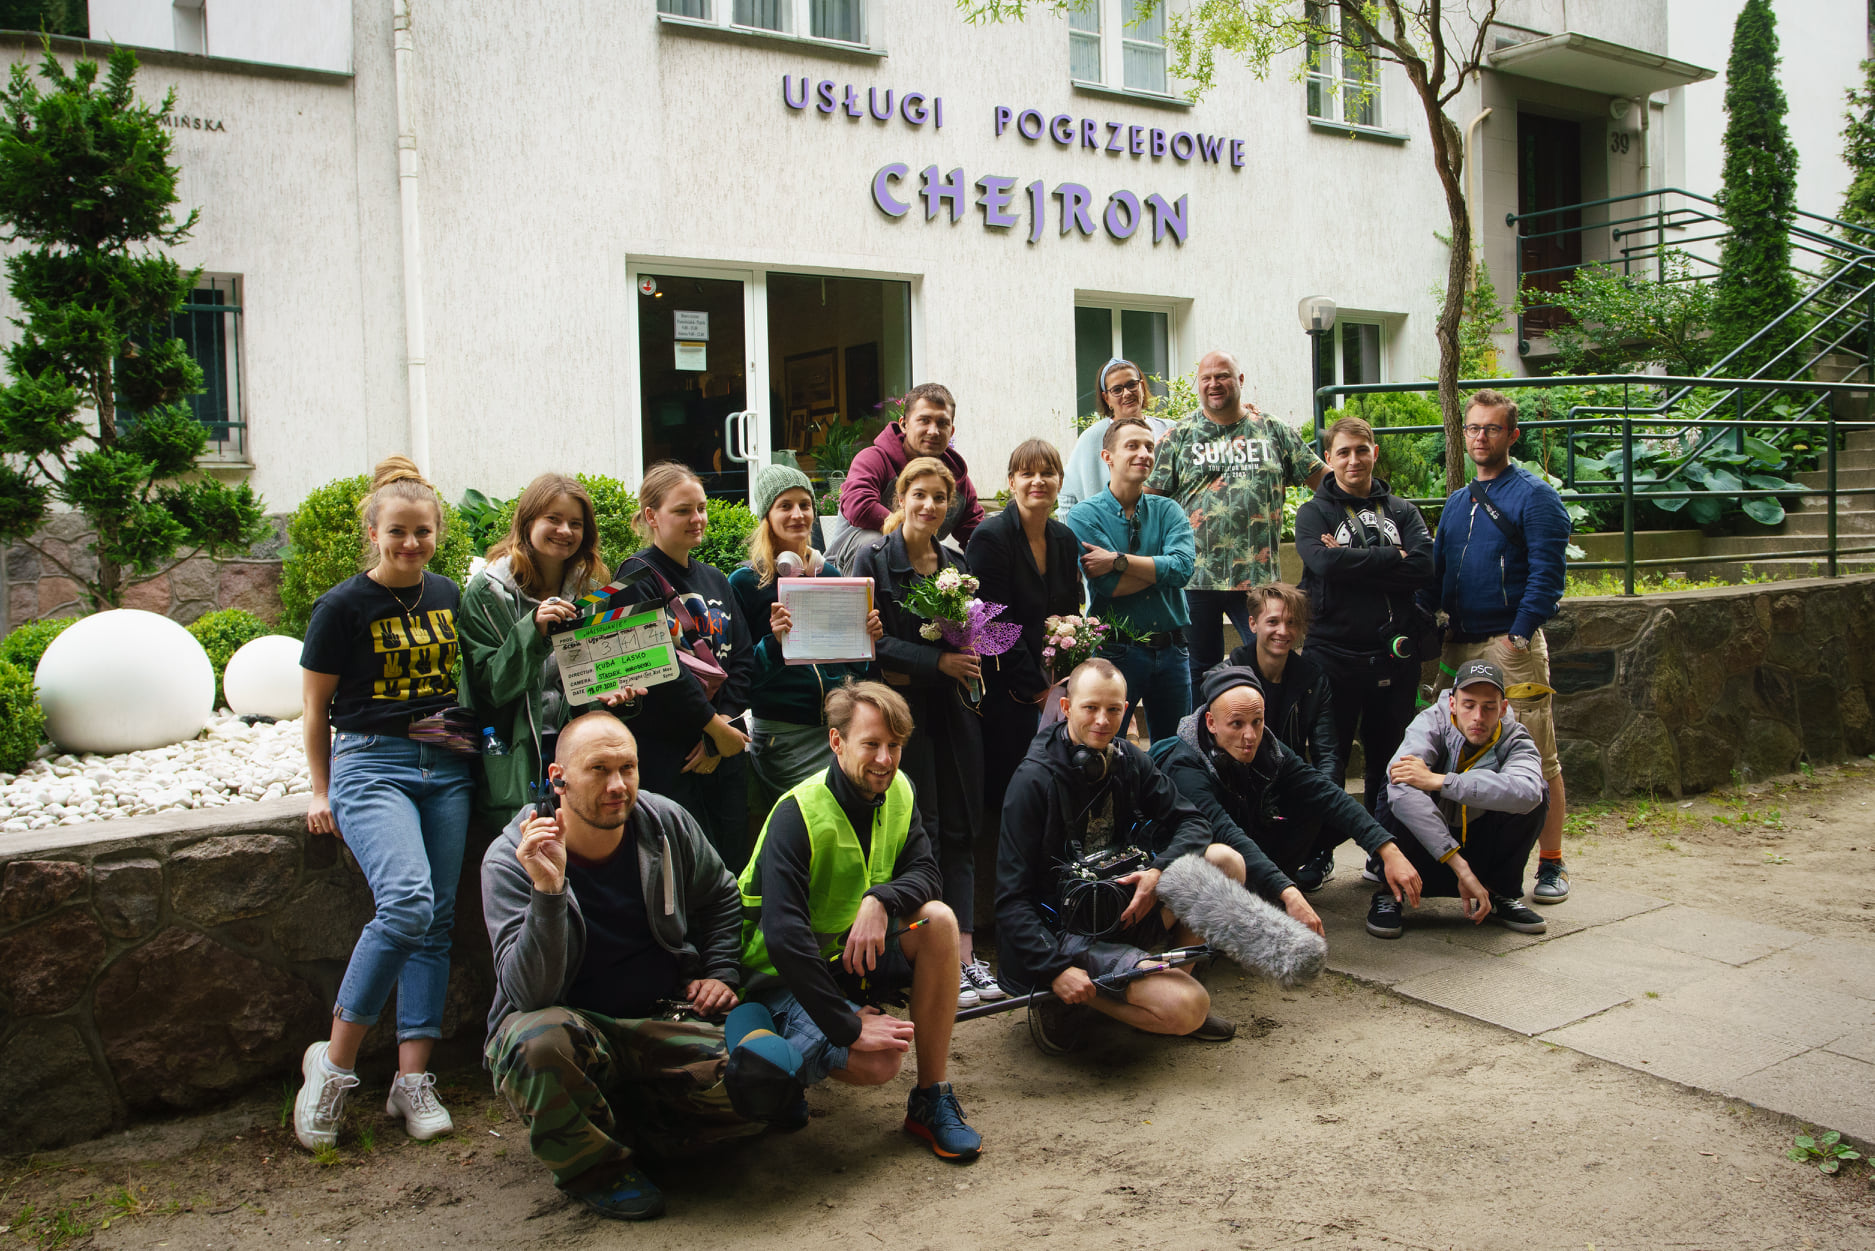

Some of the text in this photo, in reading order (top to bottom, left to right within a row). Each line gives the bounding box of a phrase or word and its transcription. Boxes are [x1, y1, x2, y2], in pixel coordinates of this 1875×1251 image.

[158, 114, 226, 132] MIŃSKA
[783, 74, 1246, 168] USŁUGI POGRZEBOWE
[1611, 131, 1630, 154] 39
[871, 162, 1188, 247] CHEJRON
[1192, 438, 1270, 466] SUNSET
[1470, 664, 1493, 676] PSC
